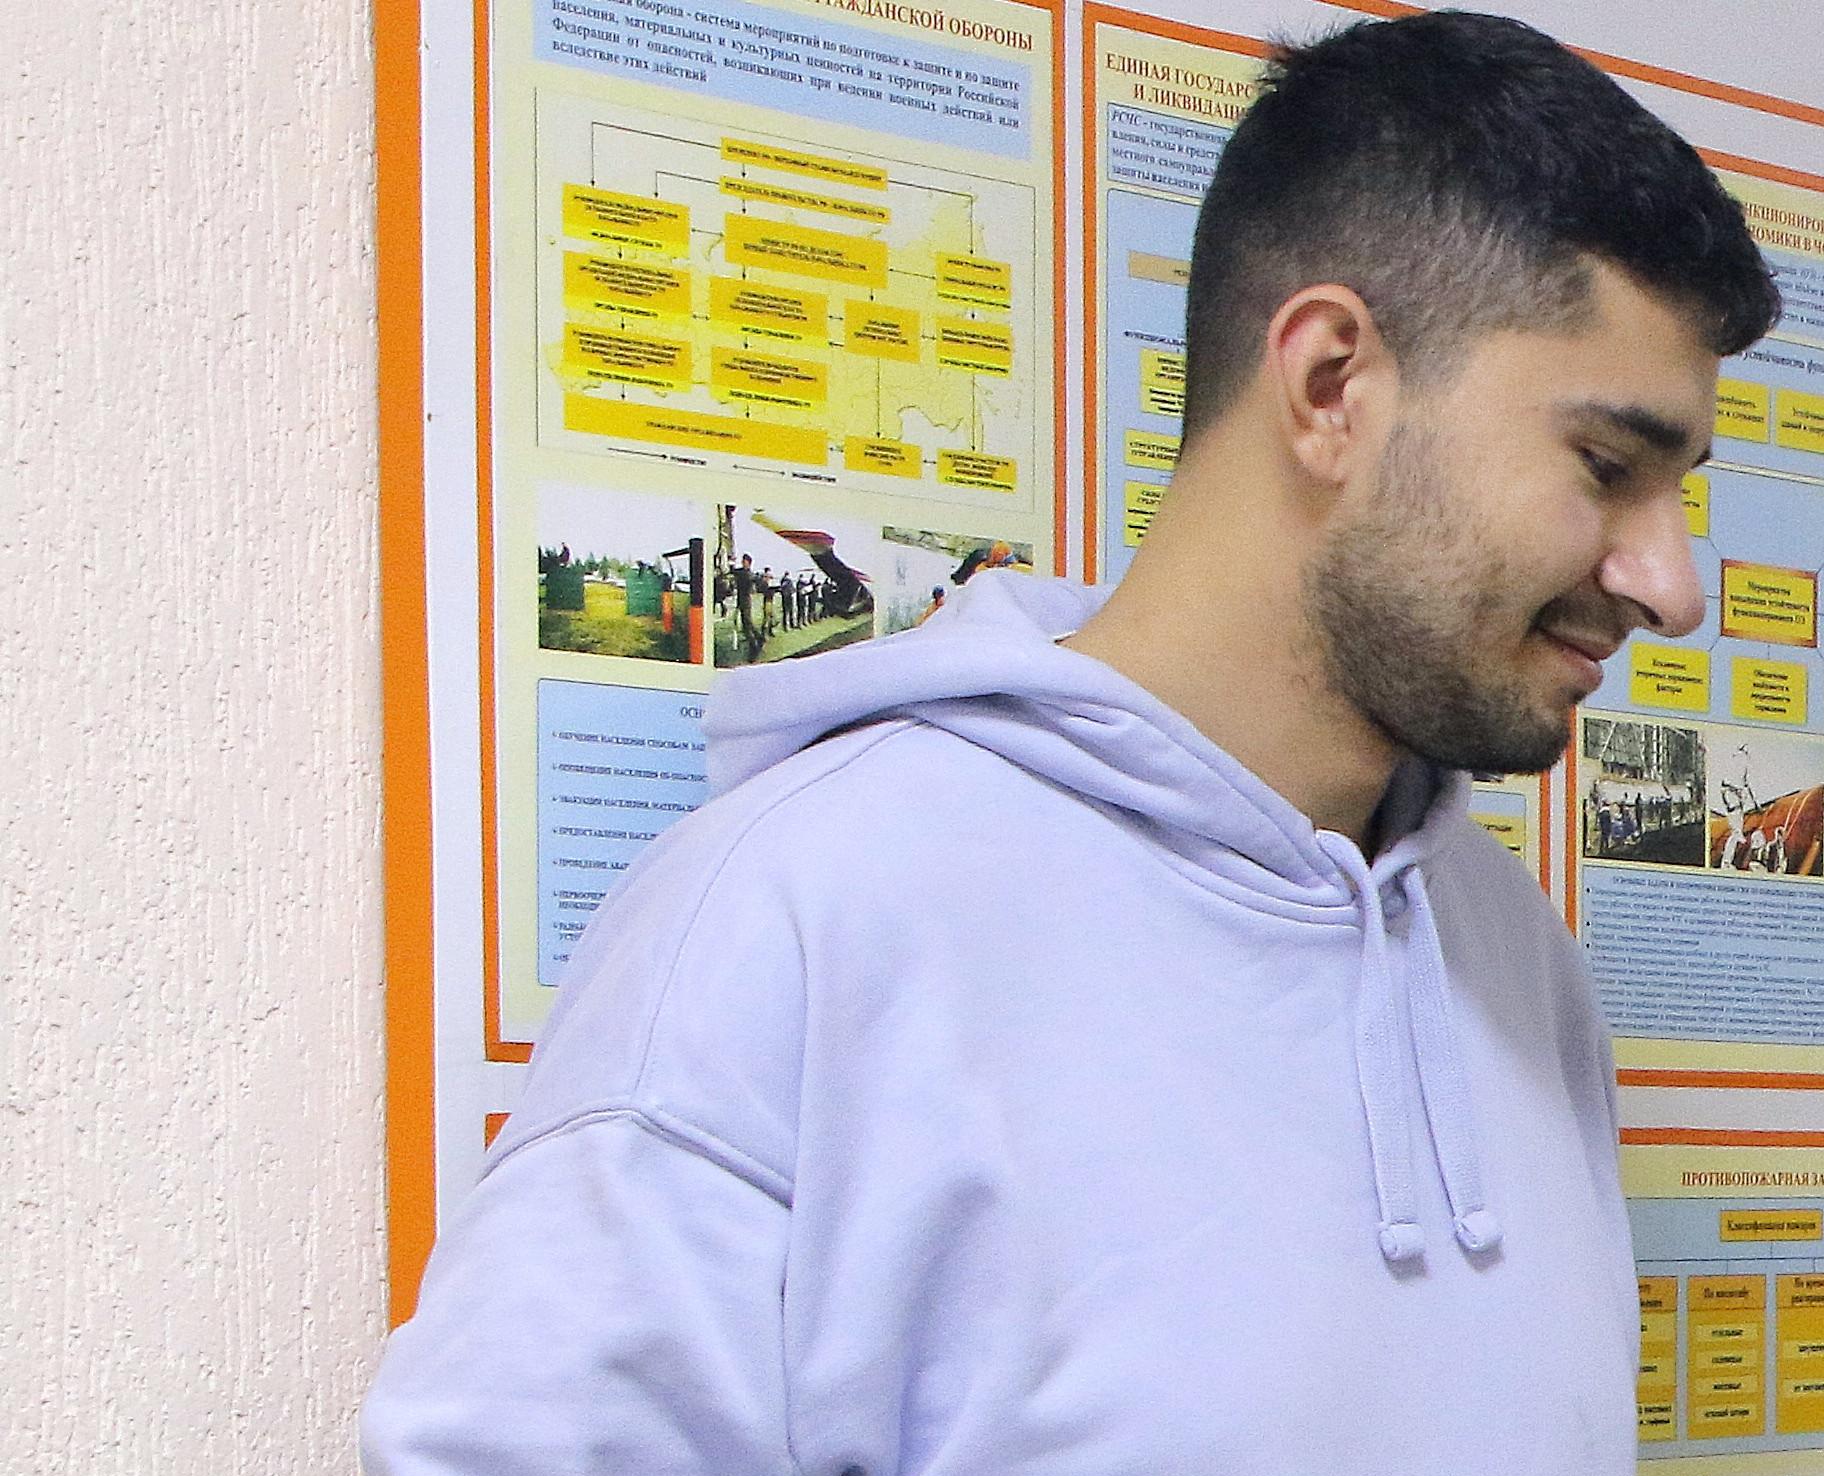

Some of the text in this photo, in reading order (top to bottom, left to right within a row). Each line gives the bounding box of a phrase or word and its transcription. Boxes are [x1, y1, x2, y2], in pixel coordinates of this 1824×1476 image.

[552, 17, 619, 43] Федерации
[624, 15, 712, 44] материальных
[731, 39, 800, 64] культурных
[695, 11, 739, 31] система
[744, 22, 819, 48] мероприятий
[811, 0, 1033, 51] АЖДАНСКОЙ ОБОРОНЫ
[1106, 52, 1253, 99] ЕДИНАЯ ГОСУДАРС
[1134, 82, 1144, 99] И
[1681, 1171, 1809, 1187] ПРОТИВОПОЖАРНАЯ
